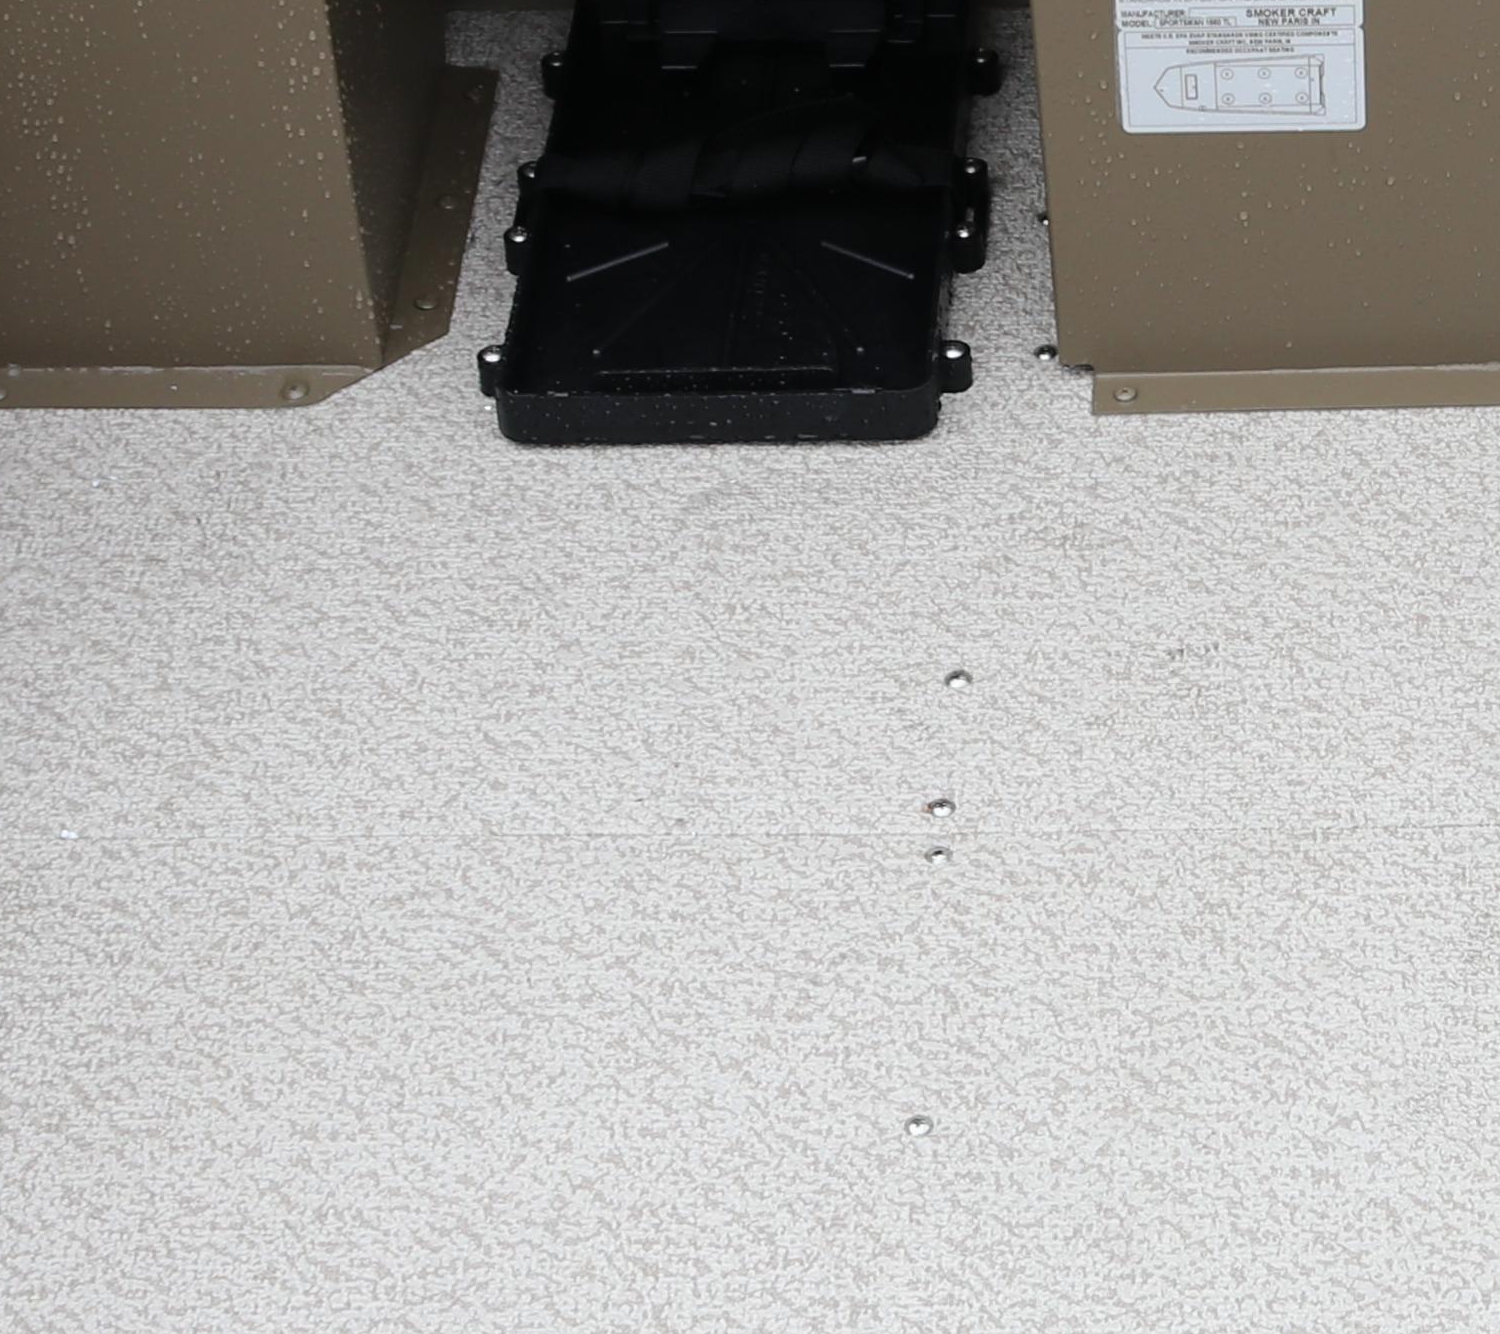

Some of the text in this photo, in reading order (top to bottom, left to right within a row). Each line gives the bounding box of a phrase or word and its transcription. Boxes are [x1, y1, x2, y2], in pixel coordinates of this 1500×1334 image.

[1246, 7, 1337, 18] SMOKER CRAFT
[1258, 17, 1321, 27] NEW PARIS IN
